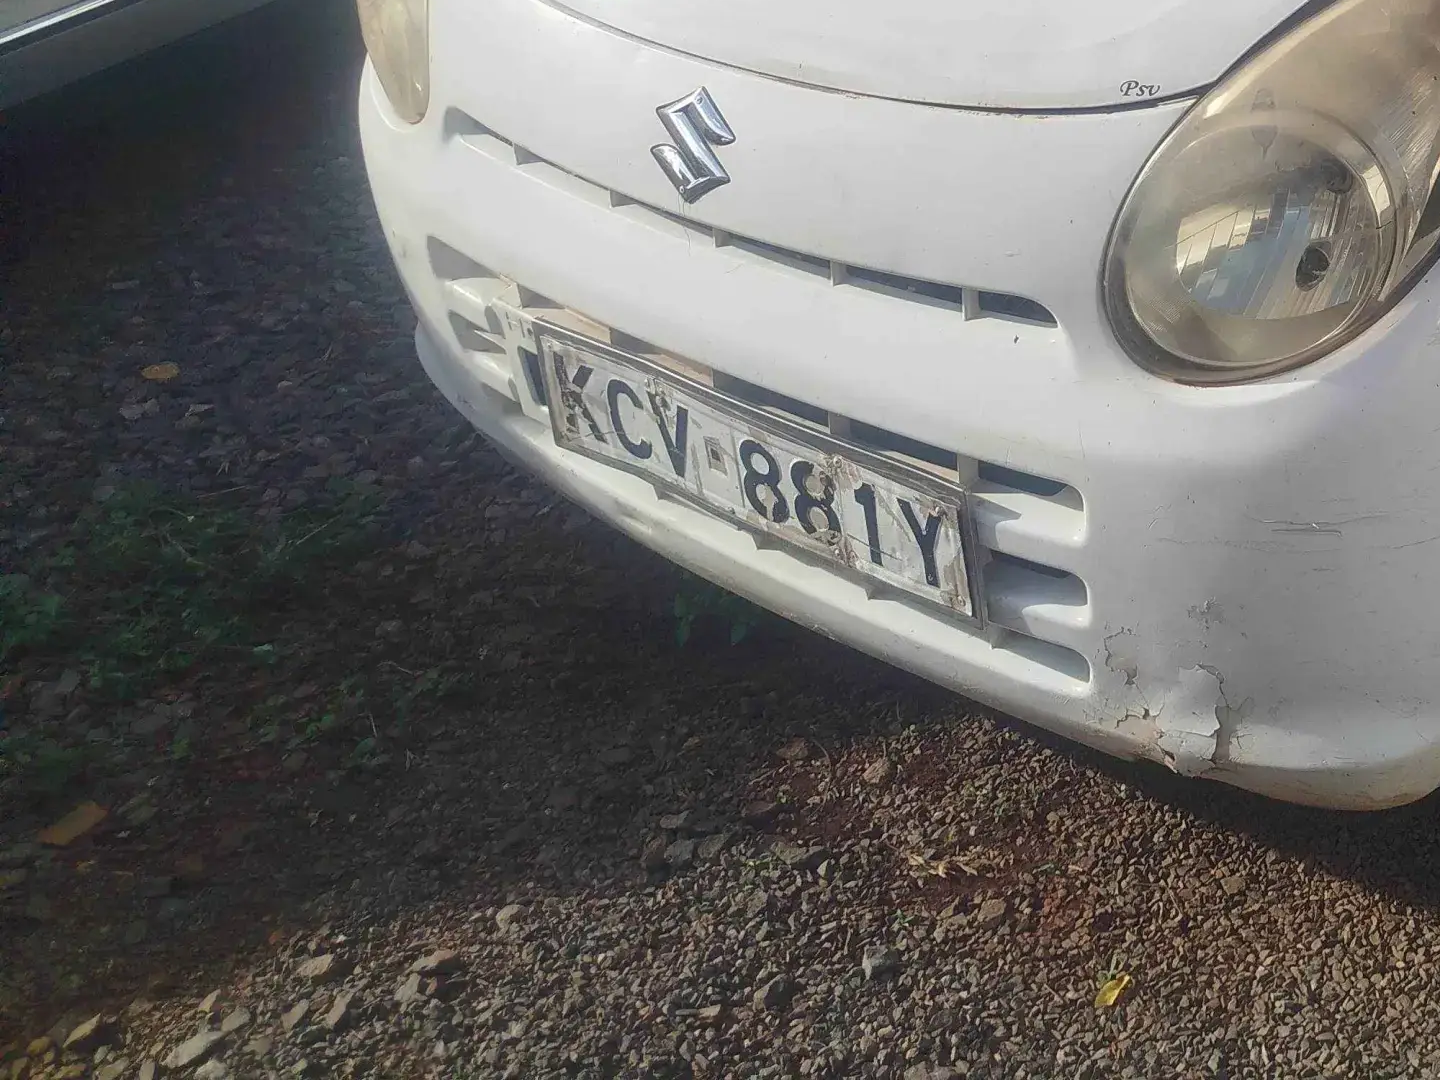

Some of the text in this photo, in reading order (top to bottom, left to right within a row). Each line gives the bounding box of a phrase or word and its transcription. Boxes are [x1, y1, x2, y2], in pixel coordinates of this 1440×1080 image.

[1120, 80, 1161, 97] Psv
[553, 350, 942, 588] KCV 881Y
